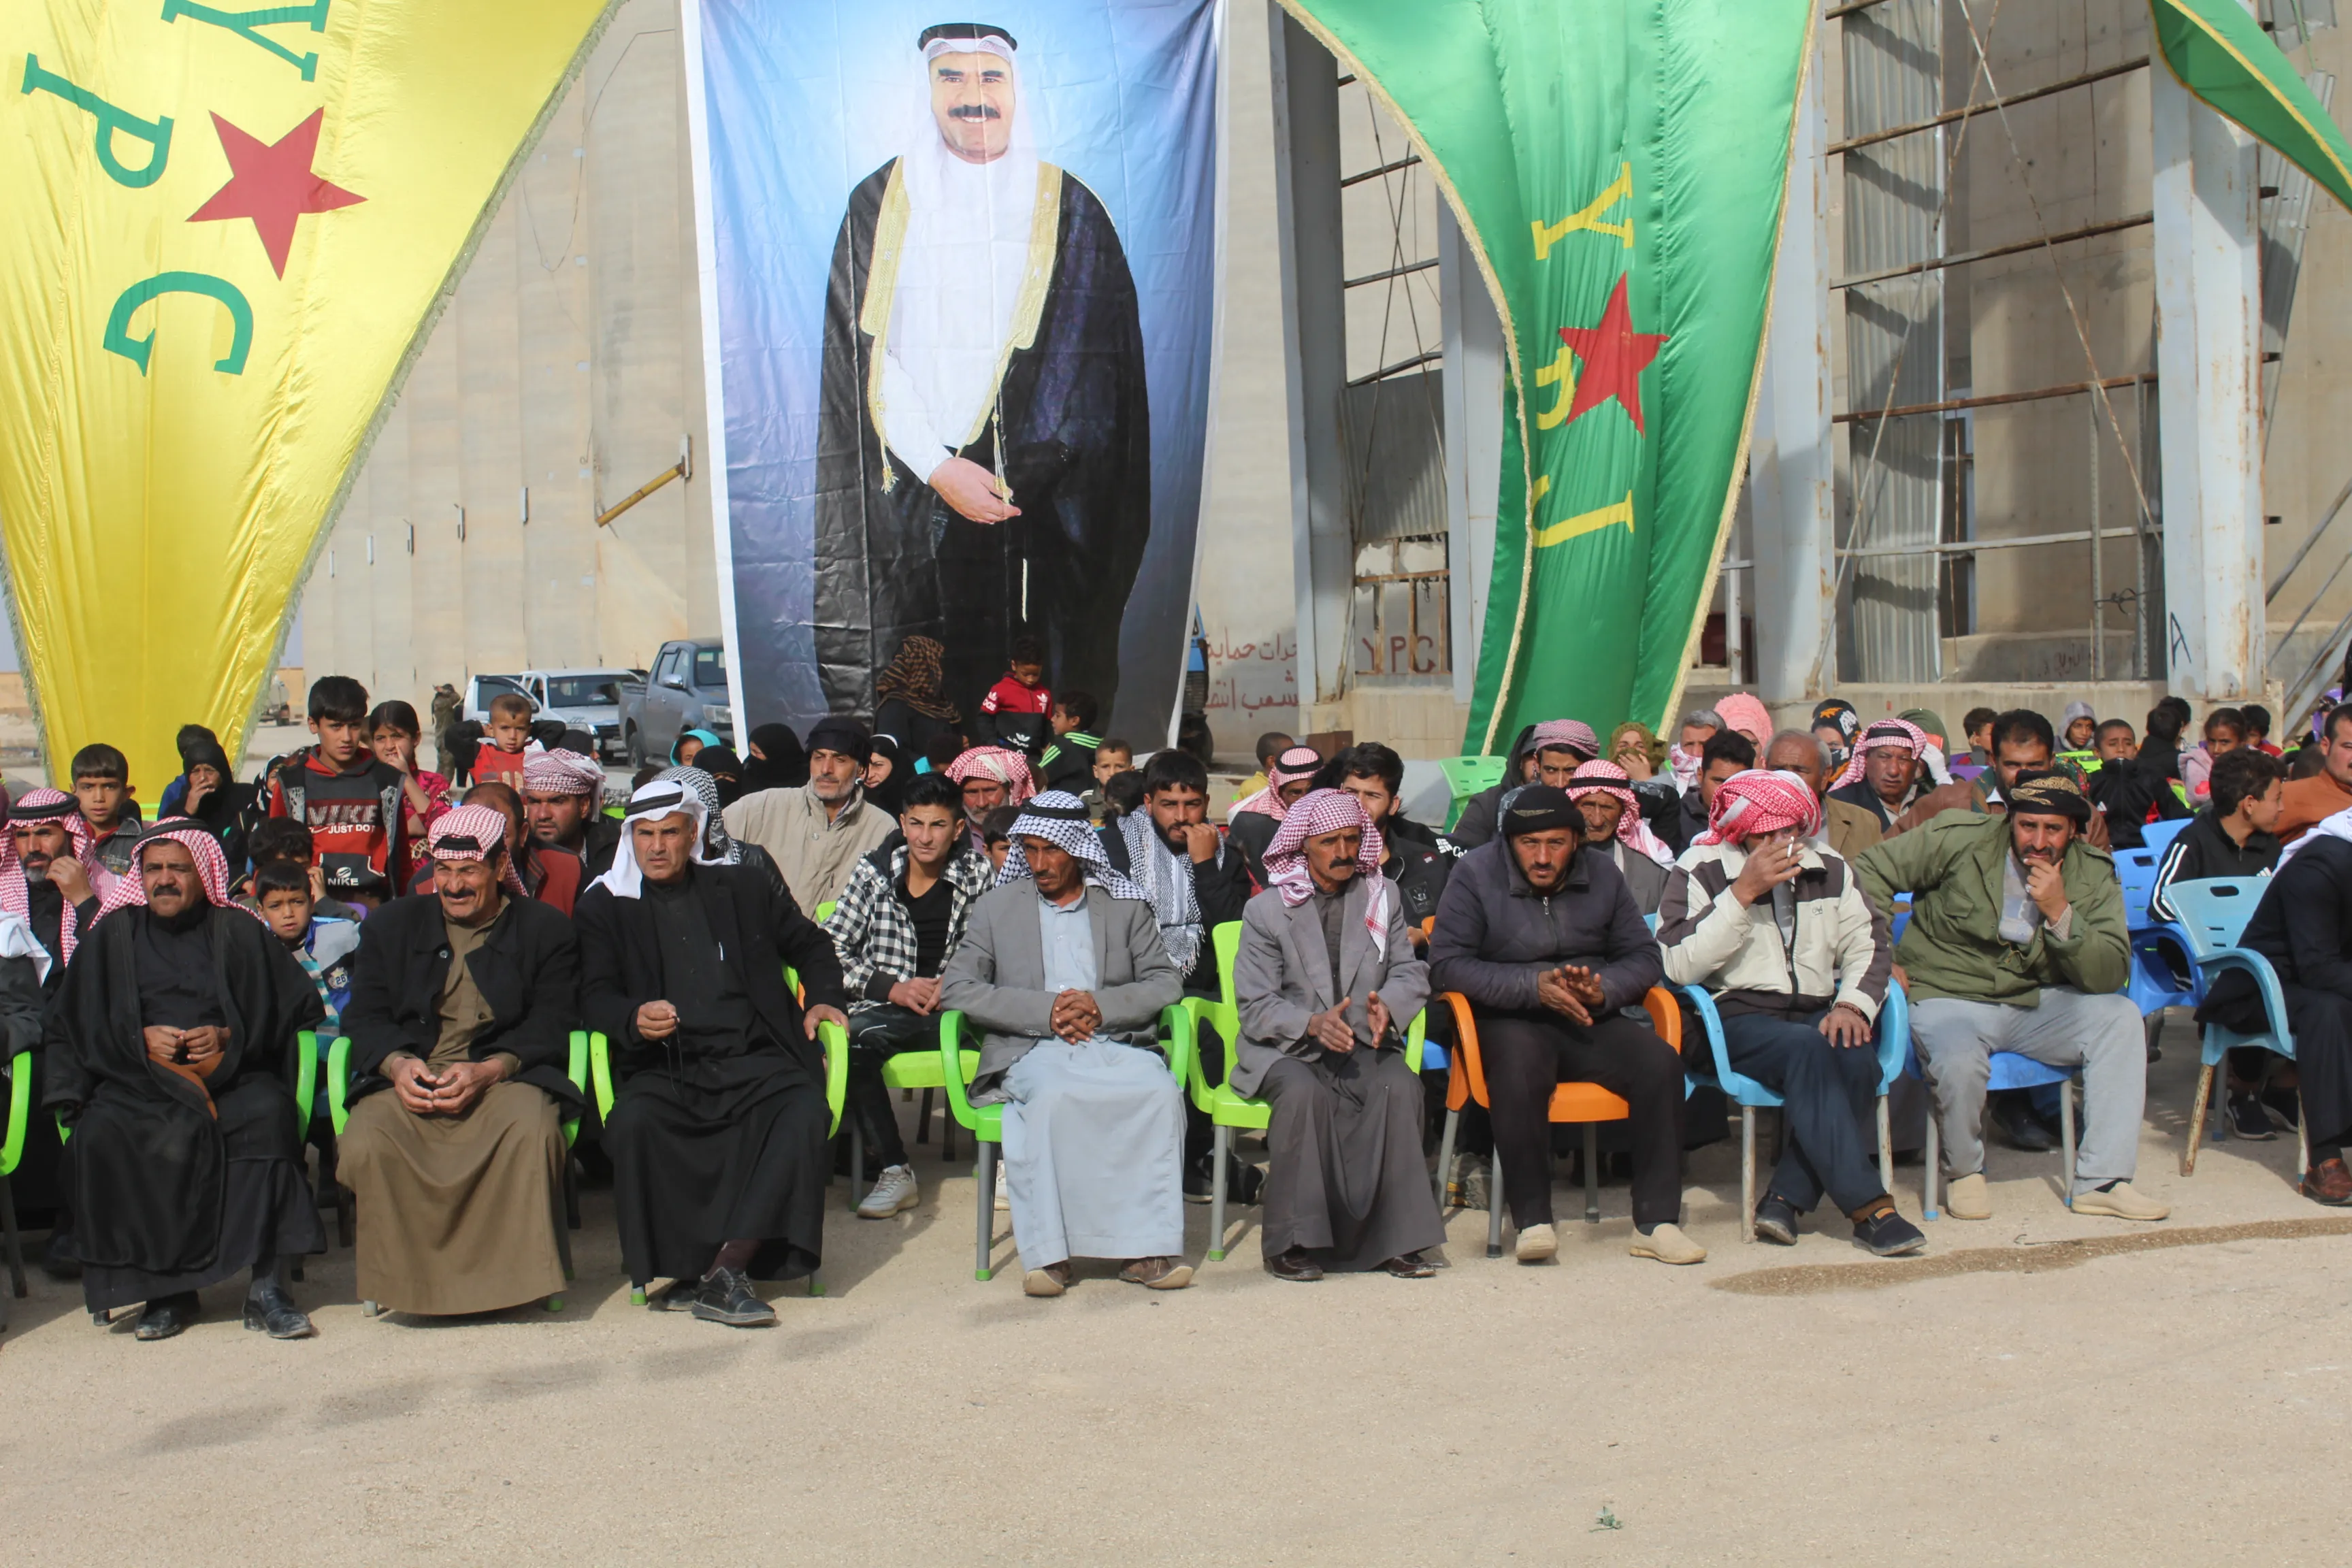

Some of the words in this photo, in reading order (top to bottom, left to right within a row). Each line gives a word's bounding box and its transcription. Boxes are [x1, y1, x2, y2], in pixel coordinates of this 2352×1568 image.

[21, 0, 330, 377] YPG
[1241, 669, 1298, 718] شعب
[308, 804, 377, 825] NIKE
[328, 825, 353, 834] JUST
[355, 823, 370, 832] DO
[327, 877, 359, 886] NIKE
